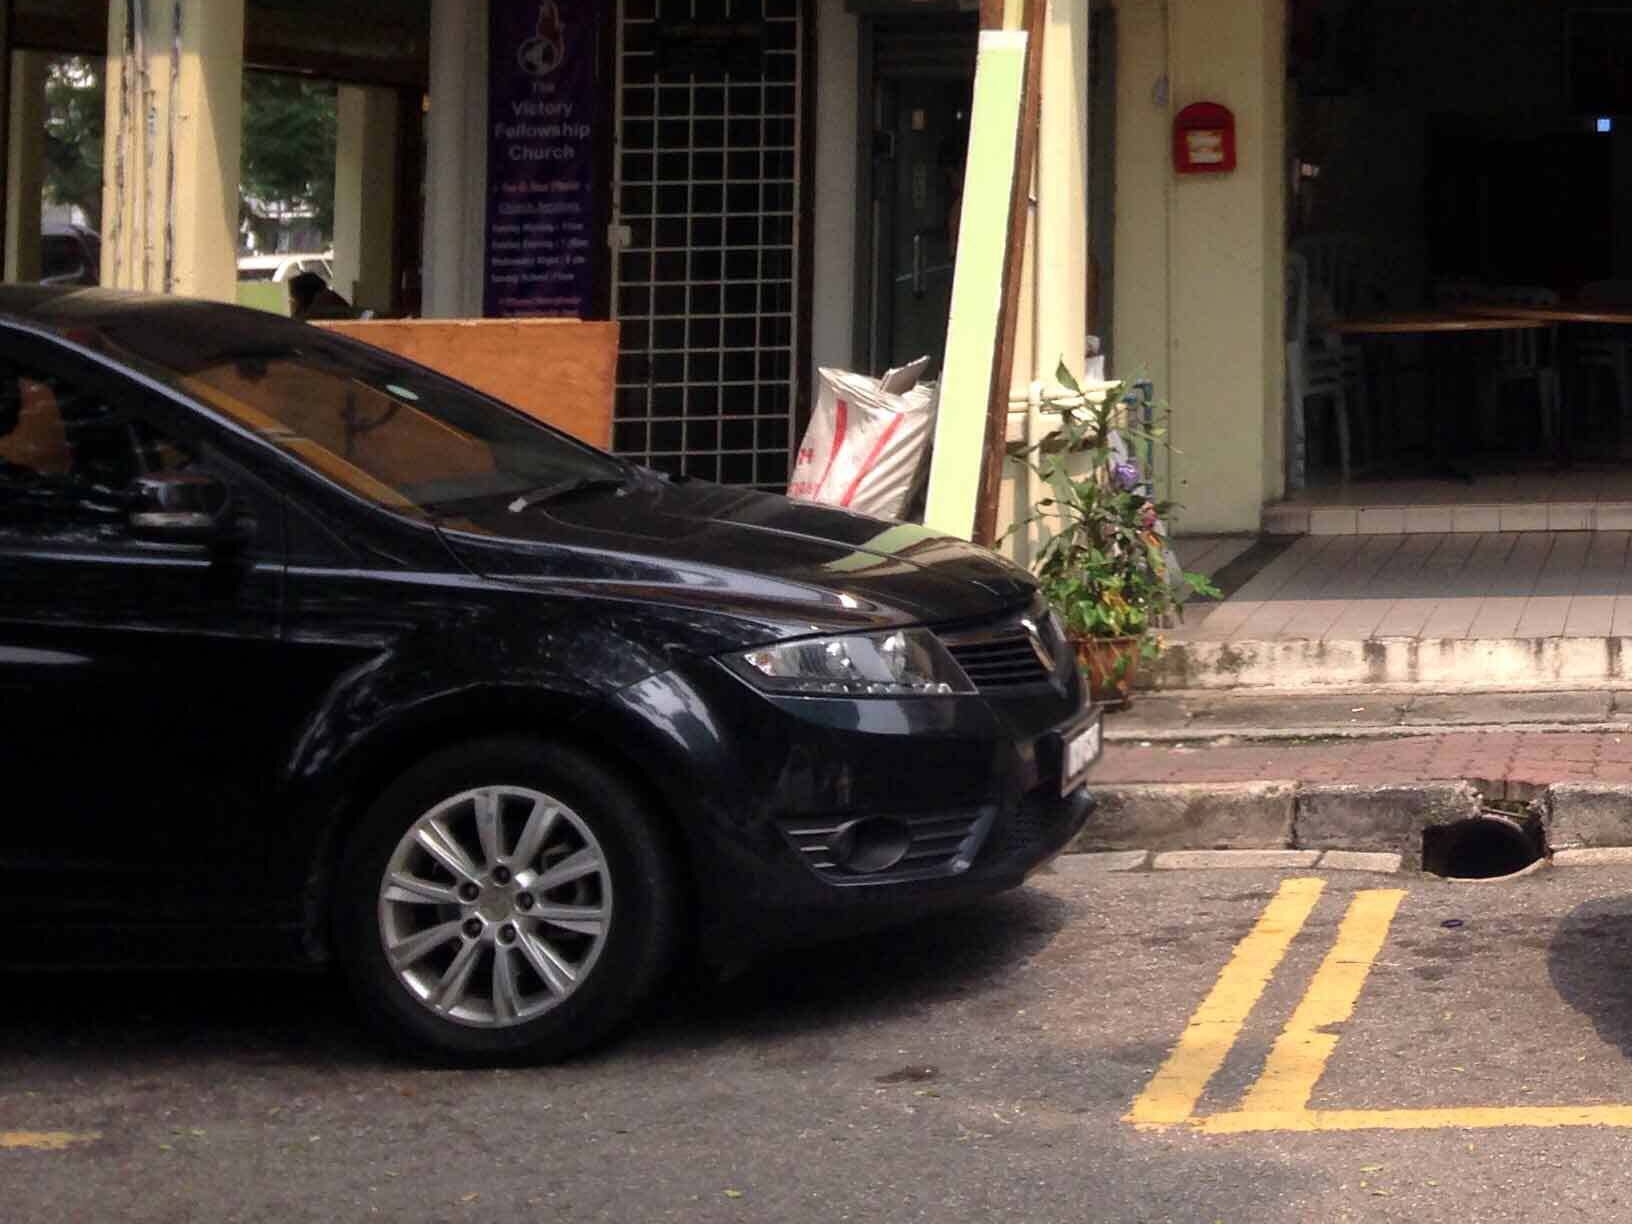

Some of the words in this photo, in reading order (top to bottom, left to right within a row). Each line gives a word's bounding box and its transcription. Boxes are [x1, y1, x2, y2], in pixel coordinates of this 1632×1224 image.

[511, 100, 573, 119] Victory
[494, 122, 591, 140] Fellowship
[508, 144, 575, 161] Church
